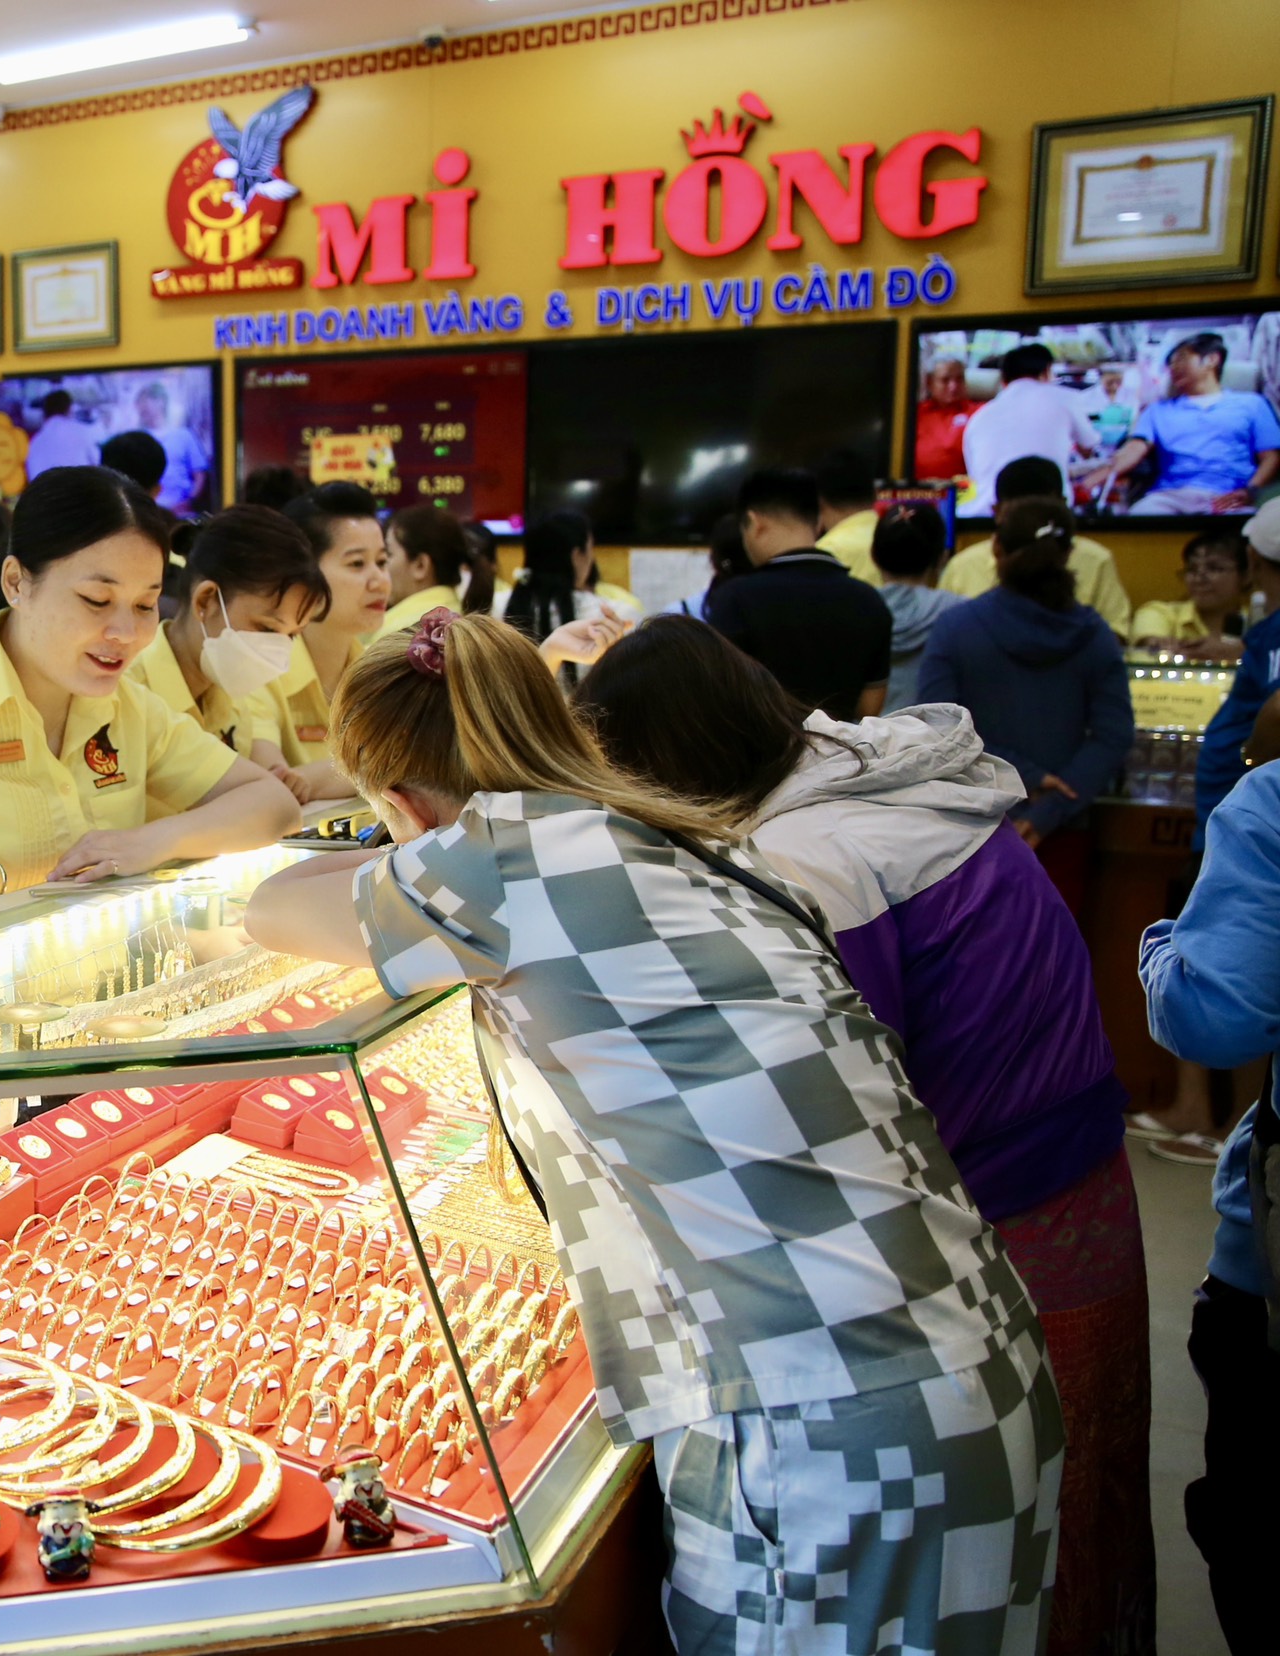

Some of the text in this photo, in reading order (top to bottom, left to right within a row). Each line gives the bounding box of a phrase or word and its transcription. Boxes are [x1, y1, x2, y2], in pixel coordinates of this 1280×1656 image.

[183, 211, 264, 266] MH
[214, 252, 957, 350] KINH DOANH VÀNG & DỊCH VỤ CẦM ĐỒ
